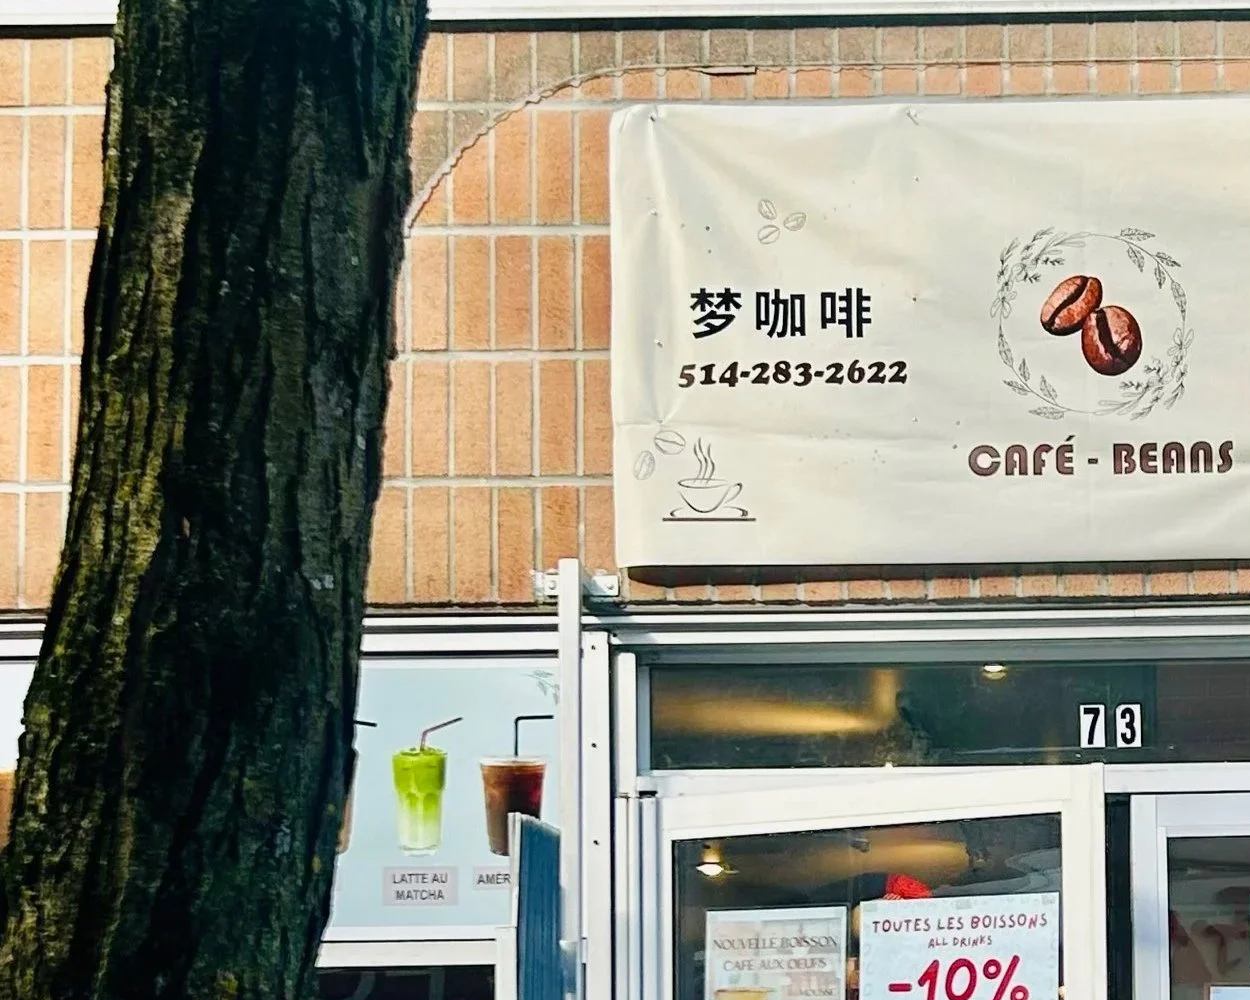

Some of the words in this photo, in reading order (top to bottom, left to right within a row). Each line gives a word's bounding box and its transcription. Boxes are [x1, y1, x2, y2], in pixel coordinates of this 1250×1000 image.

[690, 288, 872, 339] 梦咖啡
[678, 361, 908, 389] 514-283-2622
[968, 435, 1075, 477] CAFÉ
[1112, 441, 1234, 474] BEANS
[393, 873, 428, 884] LATTE
[431, 873, 448, 884] AU
[396, 889, 445, 901] MATCHA
[872, 918, 931, 933] TOUTES
[937, 916, 963, 931] LES
[970, 913, 1048, 930] BOISSONS
[713, 937, 778, 951] NOUVELLE
[781, 936, 838, 949] BOISSON
[928, 937, 950, 948] ALL
[953, 935, 993, 947] DRINKS
[760, 959, 785, 970] AUX
